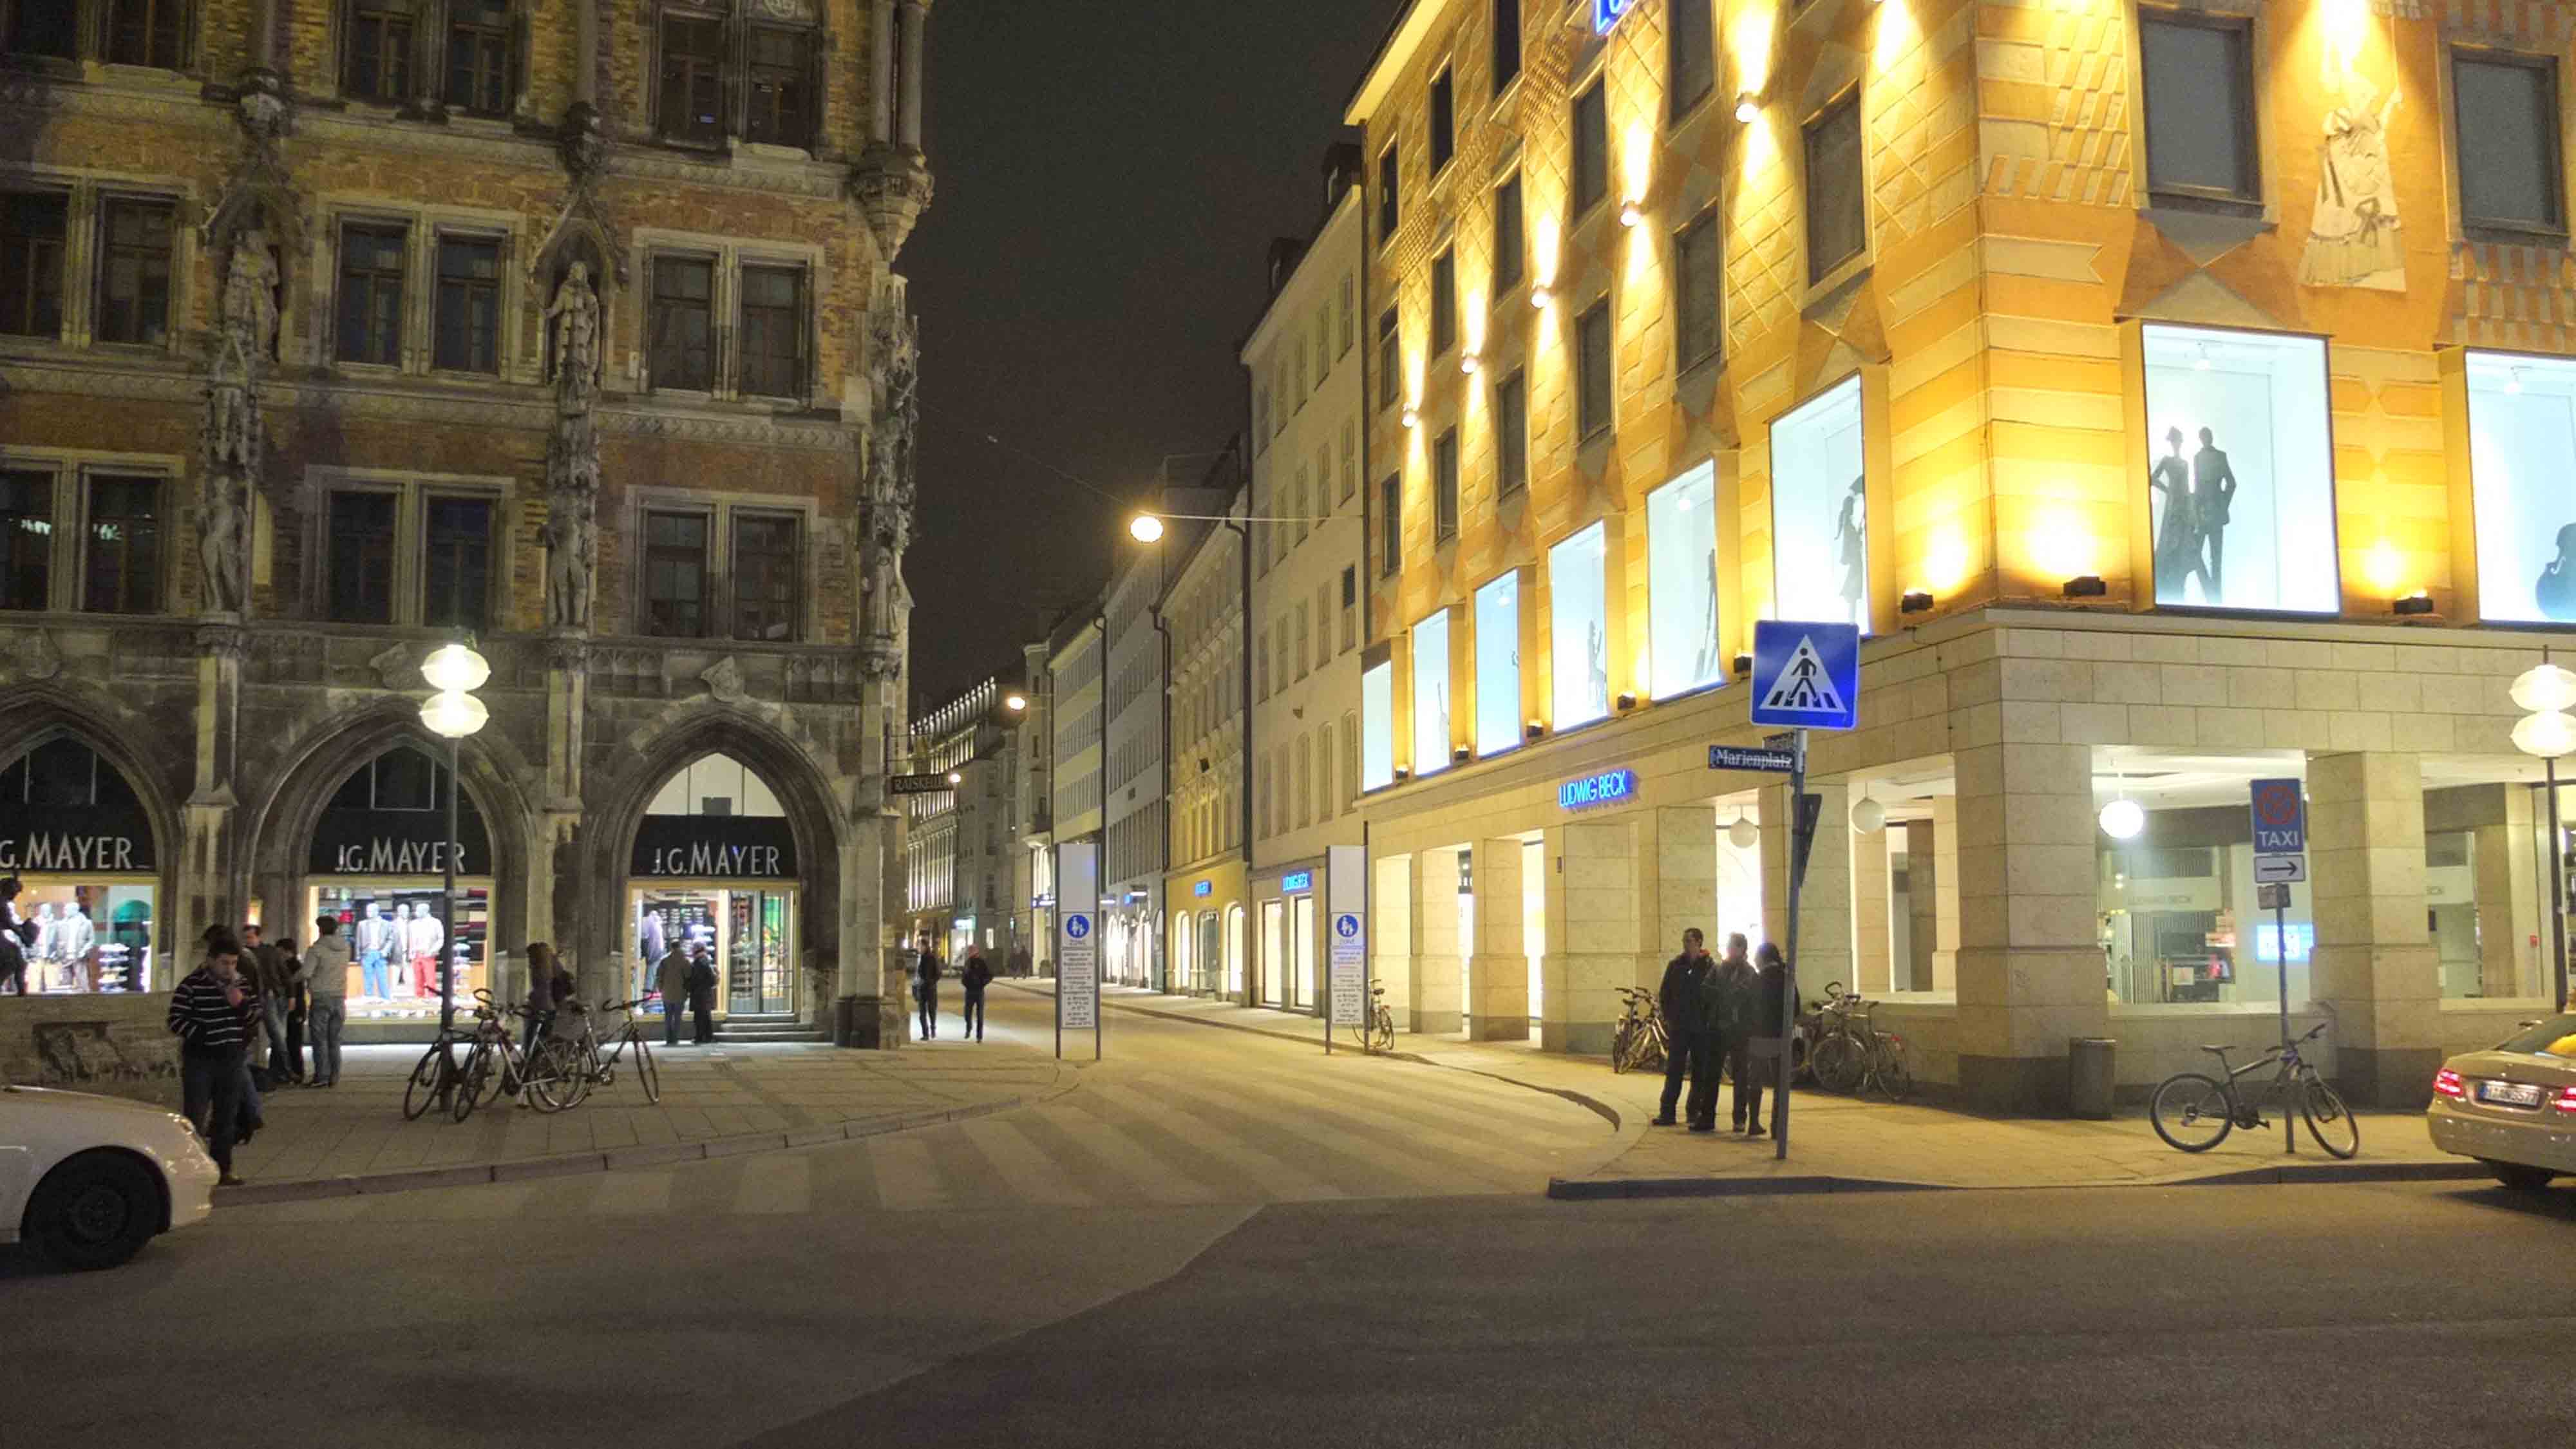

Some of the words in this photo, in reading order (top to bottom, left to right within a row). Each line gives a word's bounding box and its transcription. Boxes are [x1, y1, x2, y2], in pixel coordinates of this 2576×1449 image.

[1716, 749, 1792, 770] Marienplatz
[1558, 777, 1597, 808] LUDWIG
[1598, 770, 1627, 799] BECK
[24, 831, 133, 869] MAYER
[370, 836, 466, 873] MAYER
[2257, 830, 2298, 847] TAXI
[689, 839, 781, 875] MAYER
